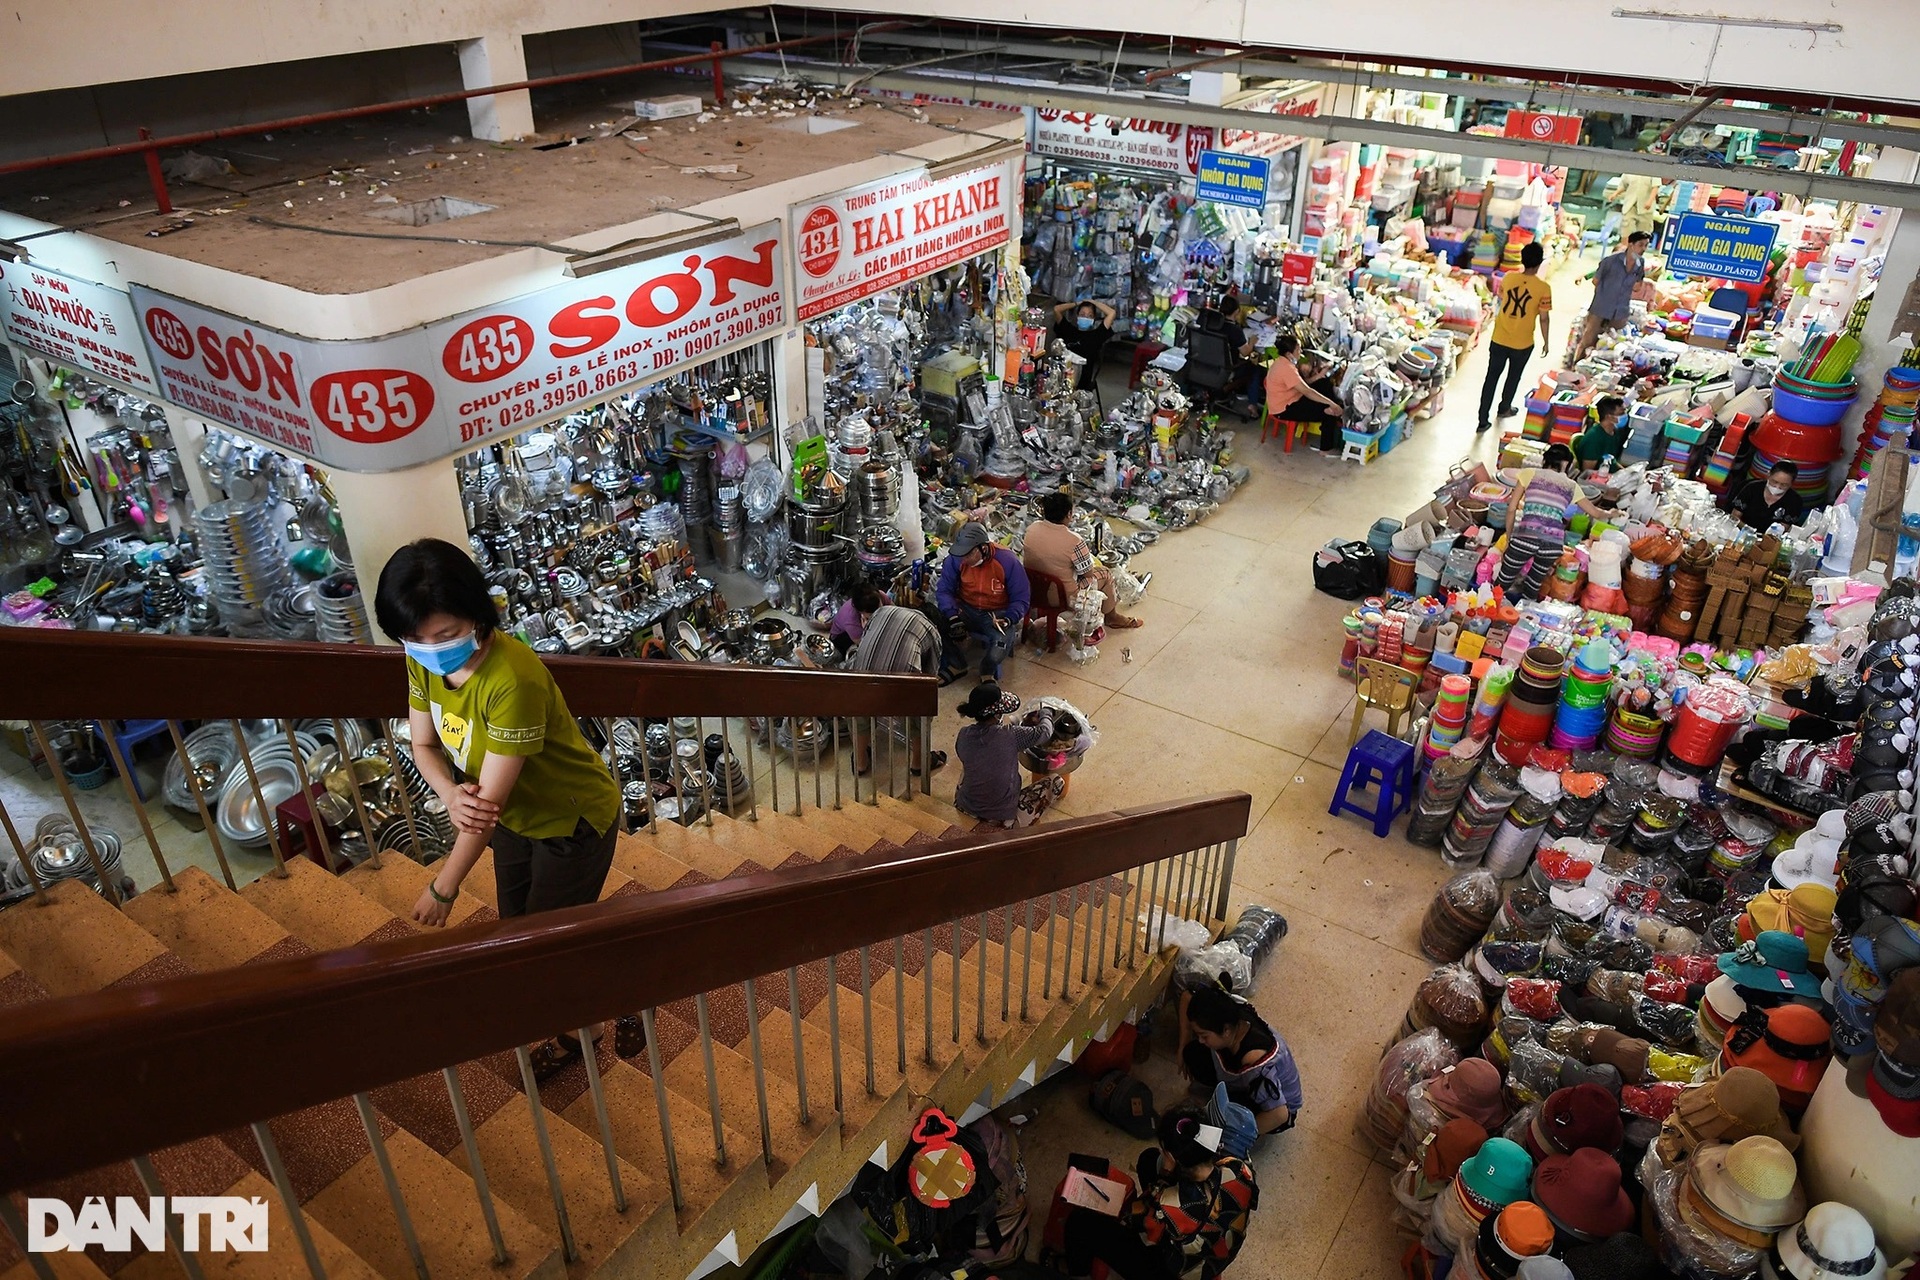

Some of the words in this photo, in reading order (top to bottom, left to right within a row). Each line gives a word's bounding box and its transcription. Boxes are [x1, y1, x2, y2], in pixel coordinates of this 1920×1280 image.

[845, 192, 876, 211] TRUNG
[879, 185, 898, 202] TÂM
[1201, 167, 1225, 185] NHÔM
[1226, 172, 1240, 188] GIA
[1241, 175, 1264, 192] DỤNG
[853, 208, 904, 256] HAI
[914, 177, 1000, 235] KHANH
[1705, 221, 1751, 235] NGÀNH
[800, 225, 840, 258] 434
[865, 255, 887, 277] CÁC
[890, 246, 912, 268] MẶT
[916, 237, 943, 259] HÀNG
[946, 225, 972, 248] NHÔM
[984, 213, 1004, 233] INOX
[1677, 234, 1710, 255] NHỰA
[1711, 238, 1731, 257] GIA
[1732, 242, 1766, 262] DỤNG
[1673, 257, 1723, 272] HOUSEHOLD
[1724, 266, 1758, 278] PLASTIS
[21, 286, 48, 319] ĐẠI
[458, 319, 523, 377] 435
[549, 239, 778, 359] SƠN
[153, 314, 188, 356] 435
[197, 325, 301, 409] SƠN
[459, 376, 541, 416] CHUYÊN
[545, 364, 565, 385] SỈ
[568, 365, 582, 378] &
[587, 350, 609, 371] LẺ
[613, 337, 653, 361] INOX
[667, 315, 713, 342] NHÔM
[715, 305, 740, 324] GIA
[743, 291, 780, 316] DỤNG
[459, 419, 493, 444] ĐT:
[499, 363, 640, 428] 028.3950.8663
[652, 348, 681, 371] DĐ:
[683, 305, 783, 358] 0907.390.997
[326, 375, 418, 433] 435
